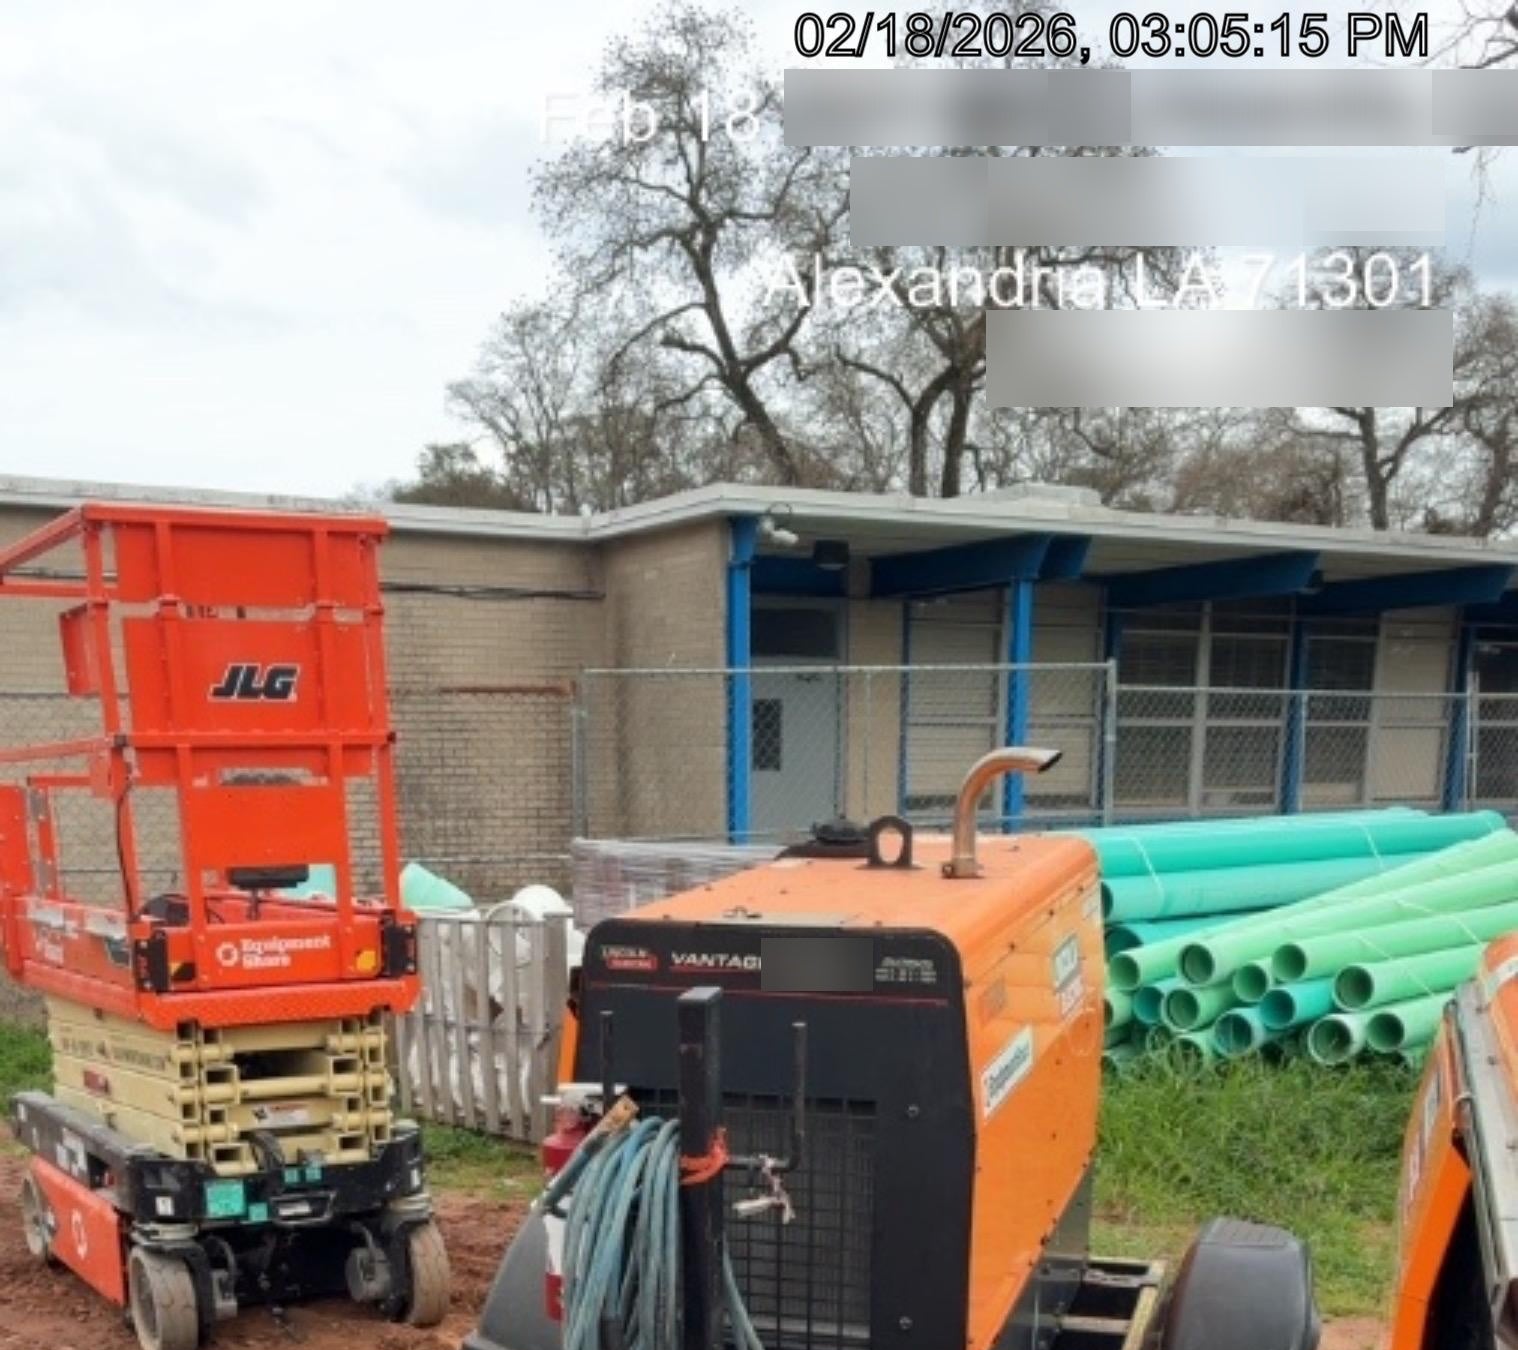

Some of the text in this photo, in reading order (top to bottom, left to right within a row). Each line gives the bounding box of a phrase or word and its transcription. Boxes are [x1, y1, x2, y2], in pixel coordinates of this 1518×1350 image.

[209, 663, 300, 702] JLG
[240, 936, 331, 954] Equipment
[671, 952, 762, 971] VANTAG
